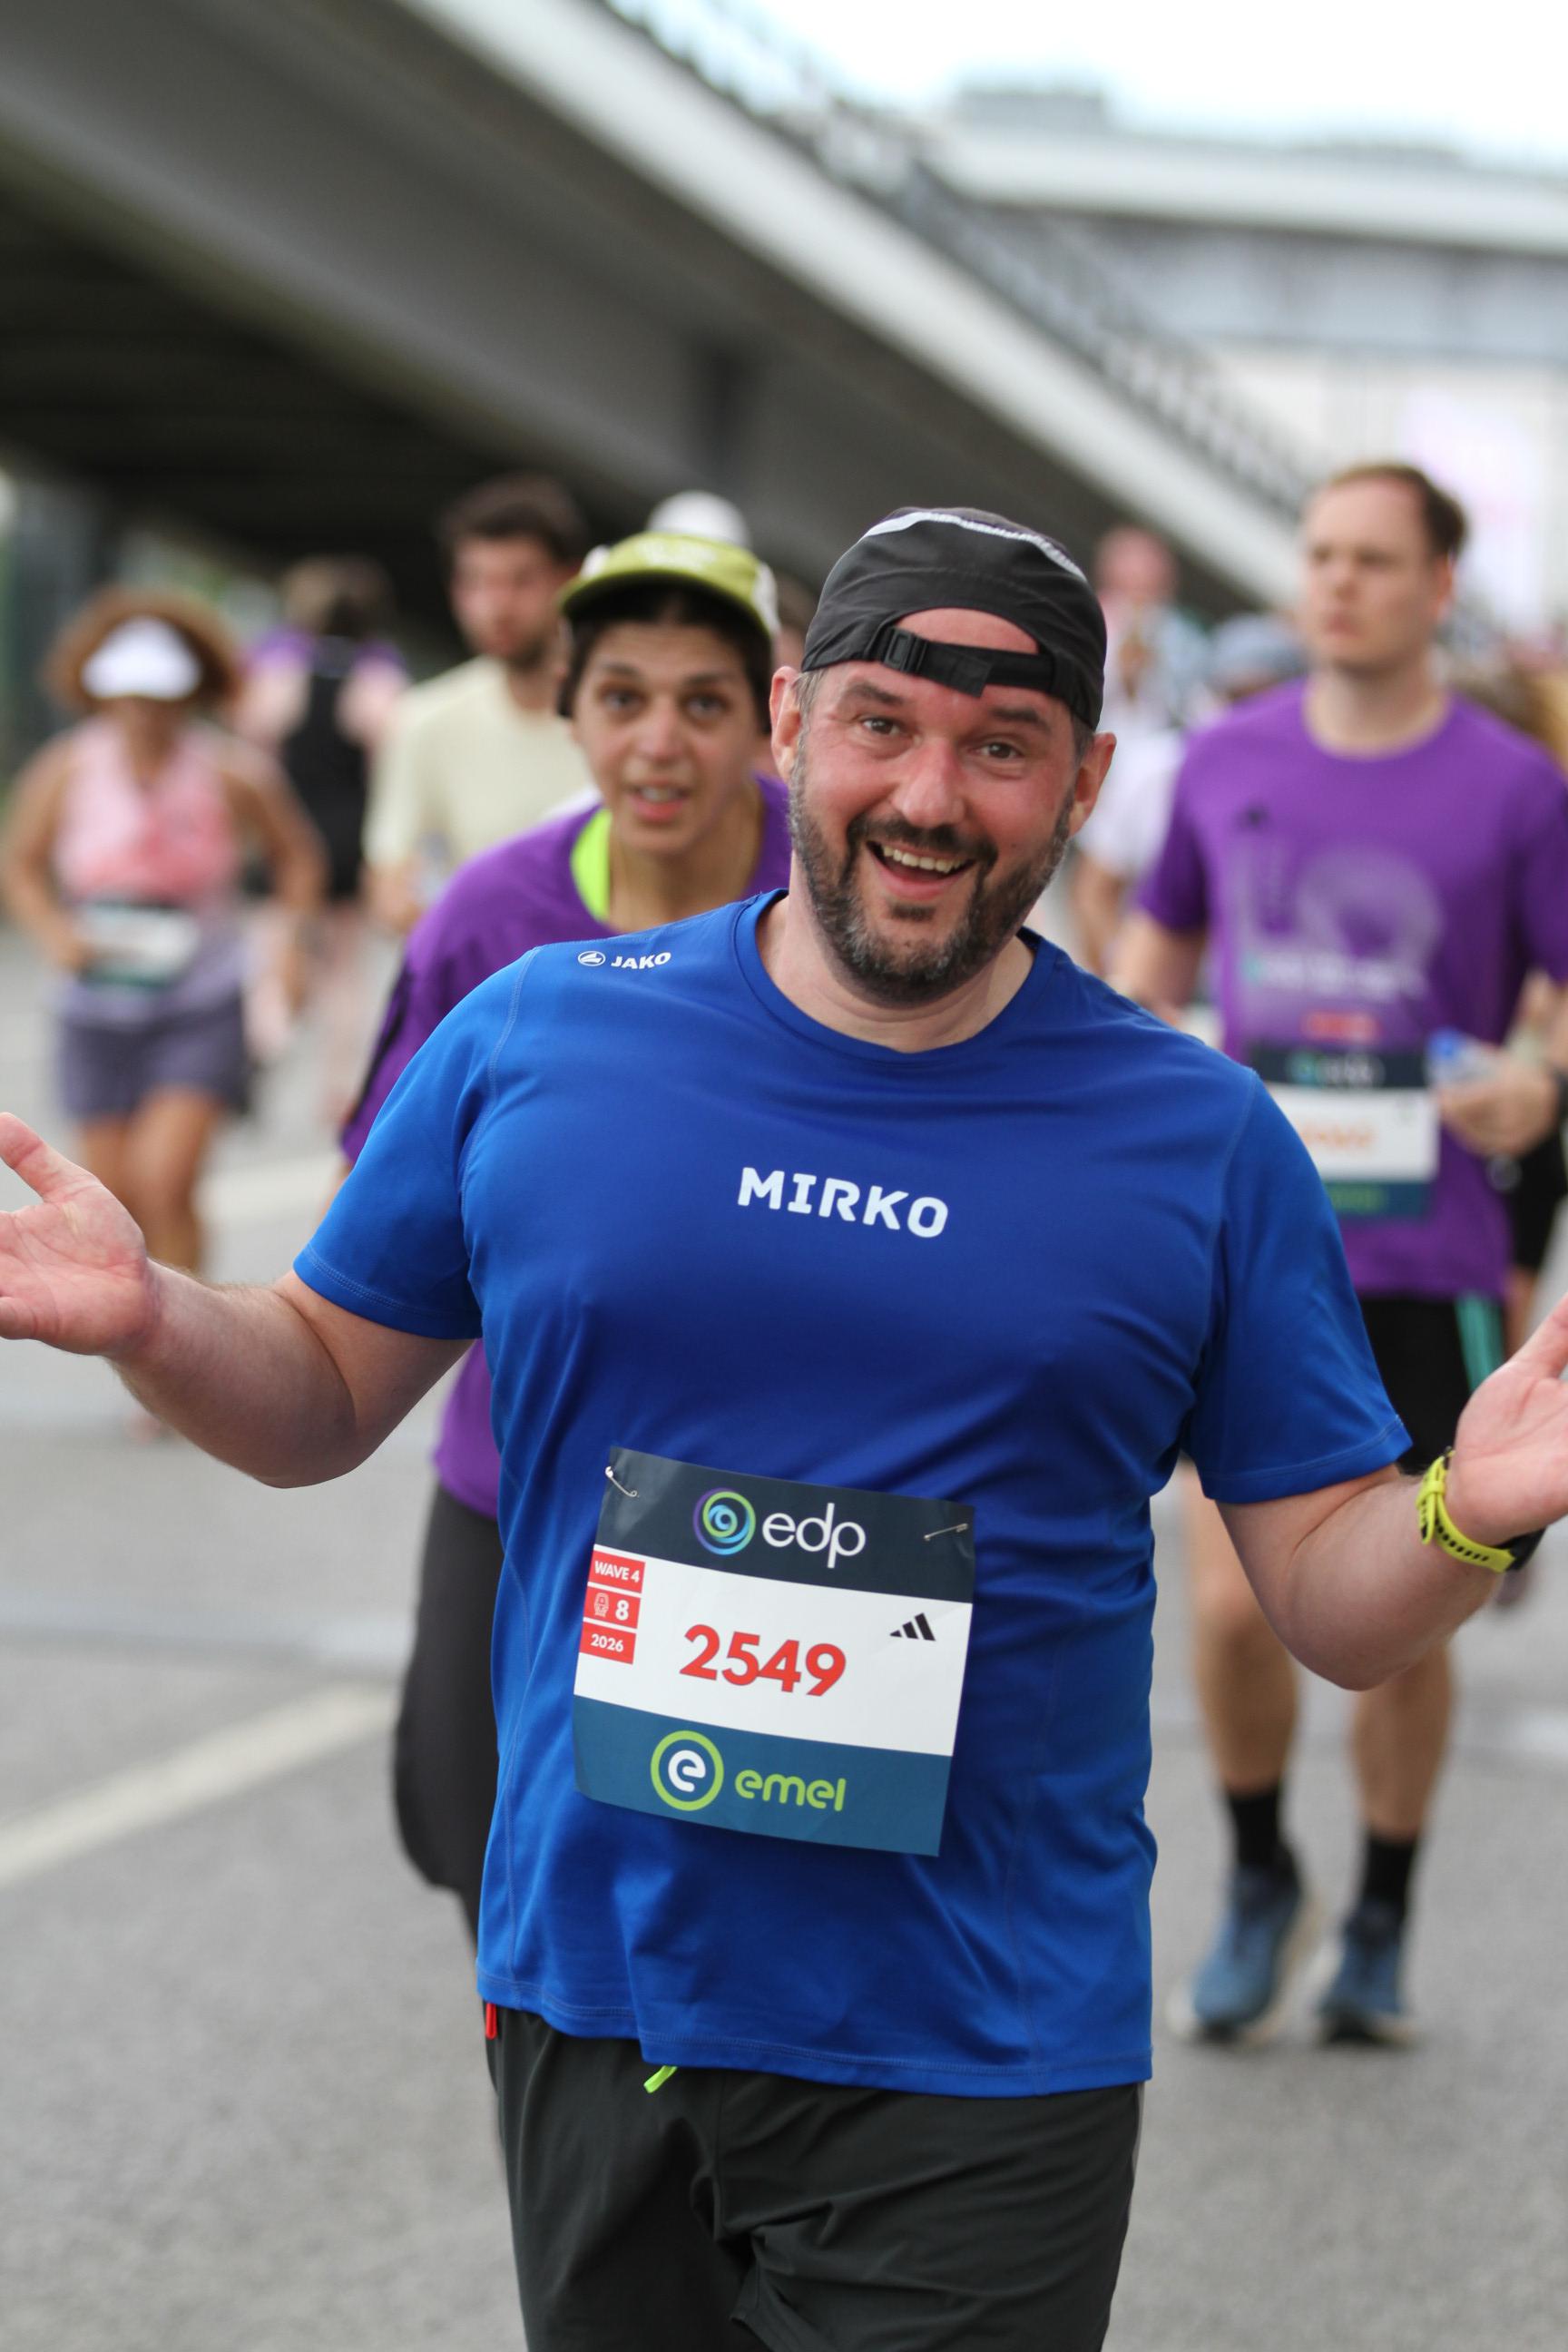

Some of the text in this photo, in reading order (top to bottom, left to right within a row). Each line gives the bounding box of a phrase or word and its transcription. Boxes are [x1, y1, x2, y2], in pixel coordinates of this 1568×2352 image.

[611, 951, 671, 969] JAKO
[738, 1167, 948, 1238] MIRKO
[761, 1502, 866, 1569] edp
[594, 1560, 641, 1583] WAVE 4
[615, 1599, 630, 1622] 8
[590, 1632, 624, 1652] 2026
[679, 1624, 847, 1697] 2549
[734, 1769, 847, 1812] emel
